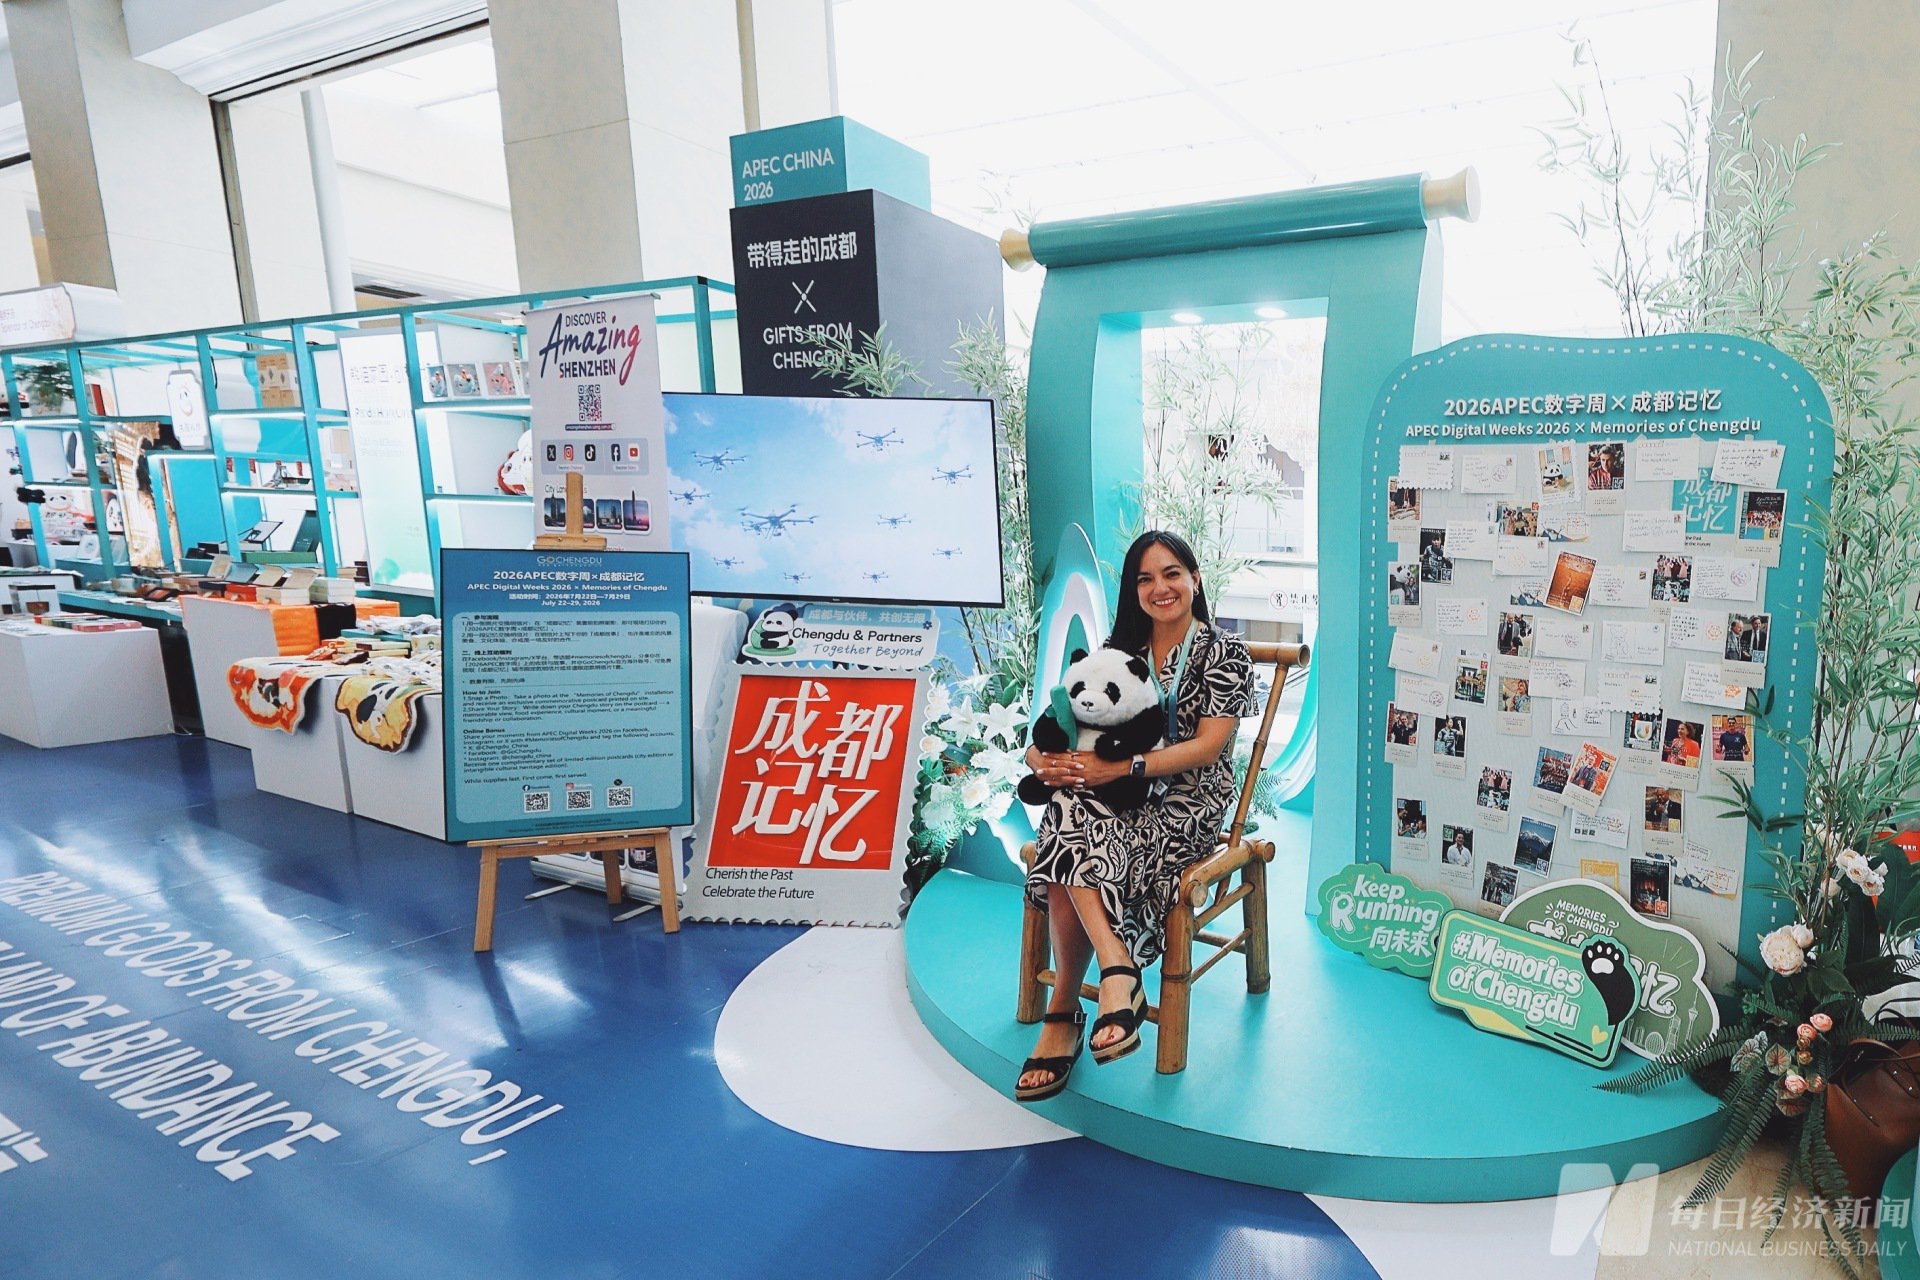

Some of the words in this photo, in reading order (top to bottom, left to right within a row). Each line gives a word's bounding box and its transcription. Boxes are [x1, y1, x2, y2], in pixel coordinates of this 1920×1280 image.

[742, 156, 781, 178] APEC
[783, 147, 836, 172] CHINA
[744, 181, 774, 201] 2026
[747, 231, 858, 269] 带得走的成都
[565, 311, 607, 328] DISCOVER
[763, 325, 804, 345] GIFTS
[808, 322, 853, 343] FROM
[539, 313, 642, 386] Amazing
[559, 359, 616, 379] SHENZHEN
[1406, 424, 1440, 437] APEC
[1442, 423, 1486, 440] Digital
[1488, 423, 1534, 436] Weeks
[1536, 422, 1570, 434] 2026
[1590, 420, 1665, 434] Memories
[1668, 418, 1685, 433] of
[1688, 417, 1761, 436] Chengdu
[1681, 496, 1728, 531] 记忆
[537, 556, 602, 564] GOCHENGDU
[492, 583, 521, 592] Digital
[633, 584, 668, 593] Chengdu
[808, 609, 926, 624] 成都与伙伴，共创无限
[793, 627, 849, 643] Chengdu
[853, 630, 864, 641] &
[868, 630, 922, 643] Partners
[814, 644, 872, 659] Together
[875, 646, 924, 658] Beyond
[735, 680, 904, 780] 成都
[731, 757, 880, 864] 记忆
[705, 868, 748, 880] Cherish
[749, 868, 769, 880] the
[770, 868, 793, 880] Past
[702, 885, 757, 898] Celebrate
[757, 886, 777, 898] the
[778, 887, 815, 899] Future
[1553, 909, 1565, 920] OF
[1567, 913, 1614, 937] CHENGDU
[1556, 899, 1607, 923] MEMORIES
[1369, 926, 1432, 958] 向未来
[1453, 931, 1583, 994] #Memories
[84, 922, 253, 987] GOODS
[186, 969, 356, 1041] FROM
[0, 995, 130, 1038] OF
[37, 1020, 341, 1182] ABUNDANCE
